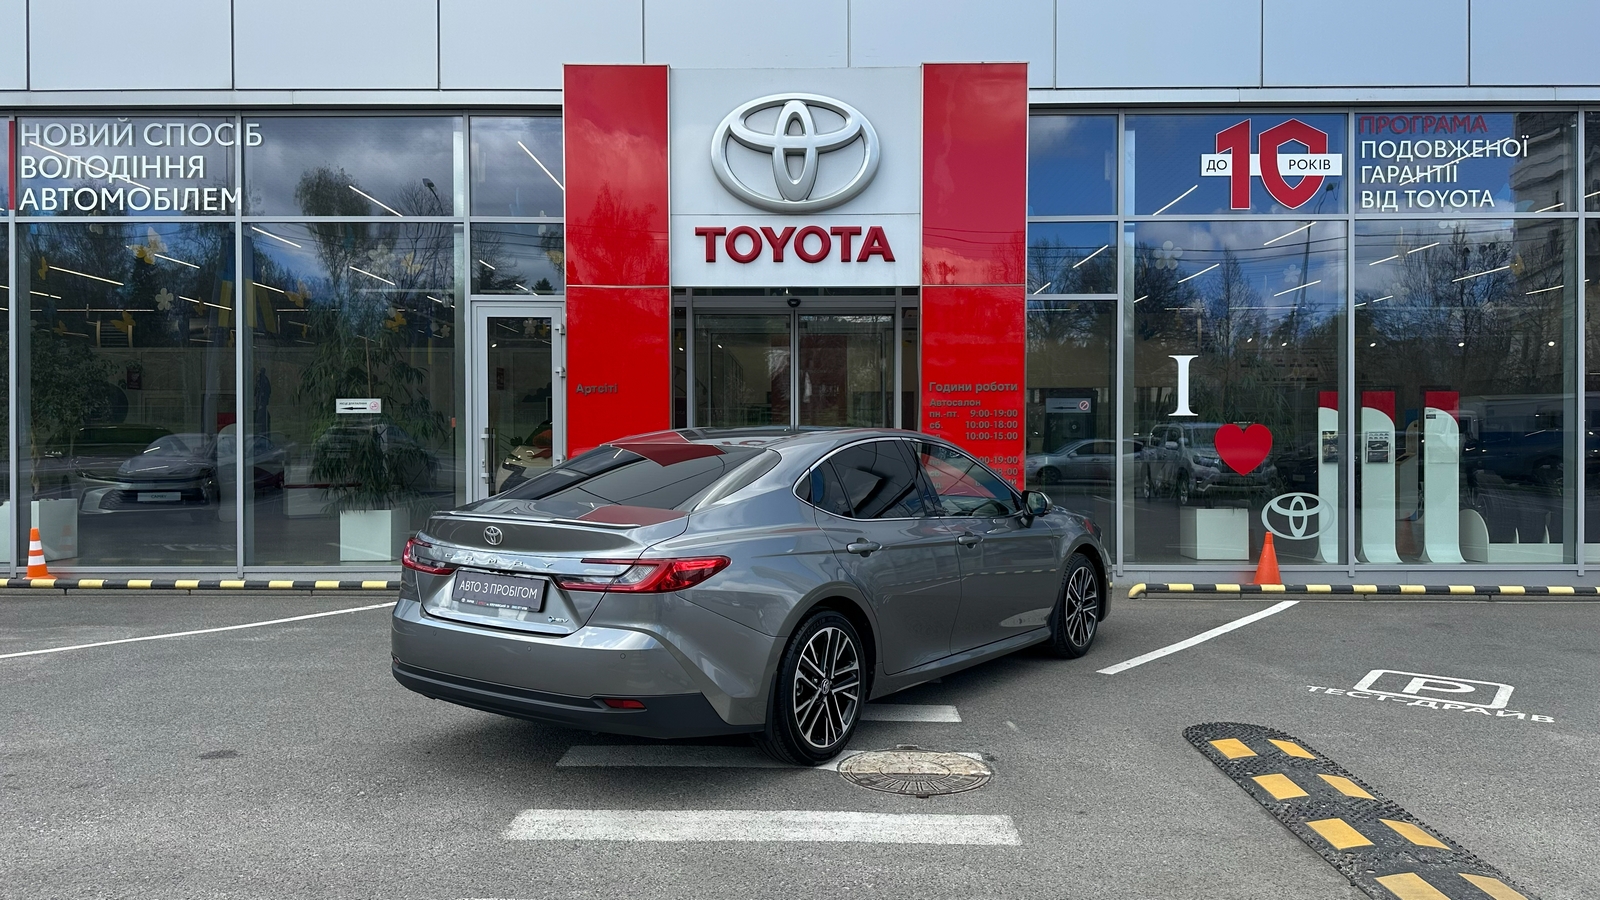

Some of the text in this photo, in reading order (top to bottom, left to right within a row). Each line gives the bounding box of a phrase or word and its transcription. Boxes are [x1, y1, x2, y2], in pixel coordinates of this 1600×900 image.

[21, 117, 262, 147] НОВИЙ СПОСІБ
[1360, 114, 1488, 134] ПРОГРАМА
[1361, 135, 1529, 161] ПОДОВЖЕНОЇ
[21, 155, 205, 183] ВОЛОДІННЯ
[1206, 118, 1332, 210] ДО 10 РОКІВ
[1361, 161, 1459, 184] ГАРАНТІЇ
[19, 187, 242, 211] АВТОМОБІЛЕМ
[1361, 190, 1495, 212] ВІД TOYOTA
[695, 225, 895, 263] TOYOTA
[575, 383, 618, 396] Артсіті
[929, 381, 1018, 394] Години роботи
[1168, 354, 1198, 416] I
[929, 420, 1018, 429] сб. 10:00-18:00
[970, 409, 1018, 418] 9:00-19:00
[965, 431, 1018, 440] 10:00-15:00
[459, 580, 482, 592] АВТО
[489, 583, 538, 600] ПРОБІГОМ
[1402, 677, 1476, 695] P
[1306, 685, 1556, 723] ТЕСТ-ДРАЙВ
